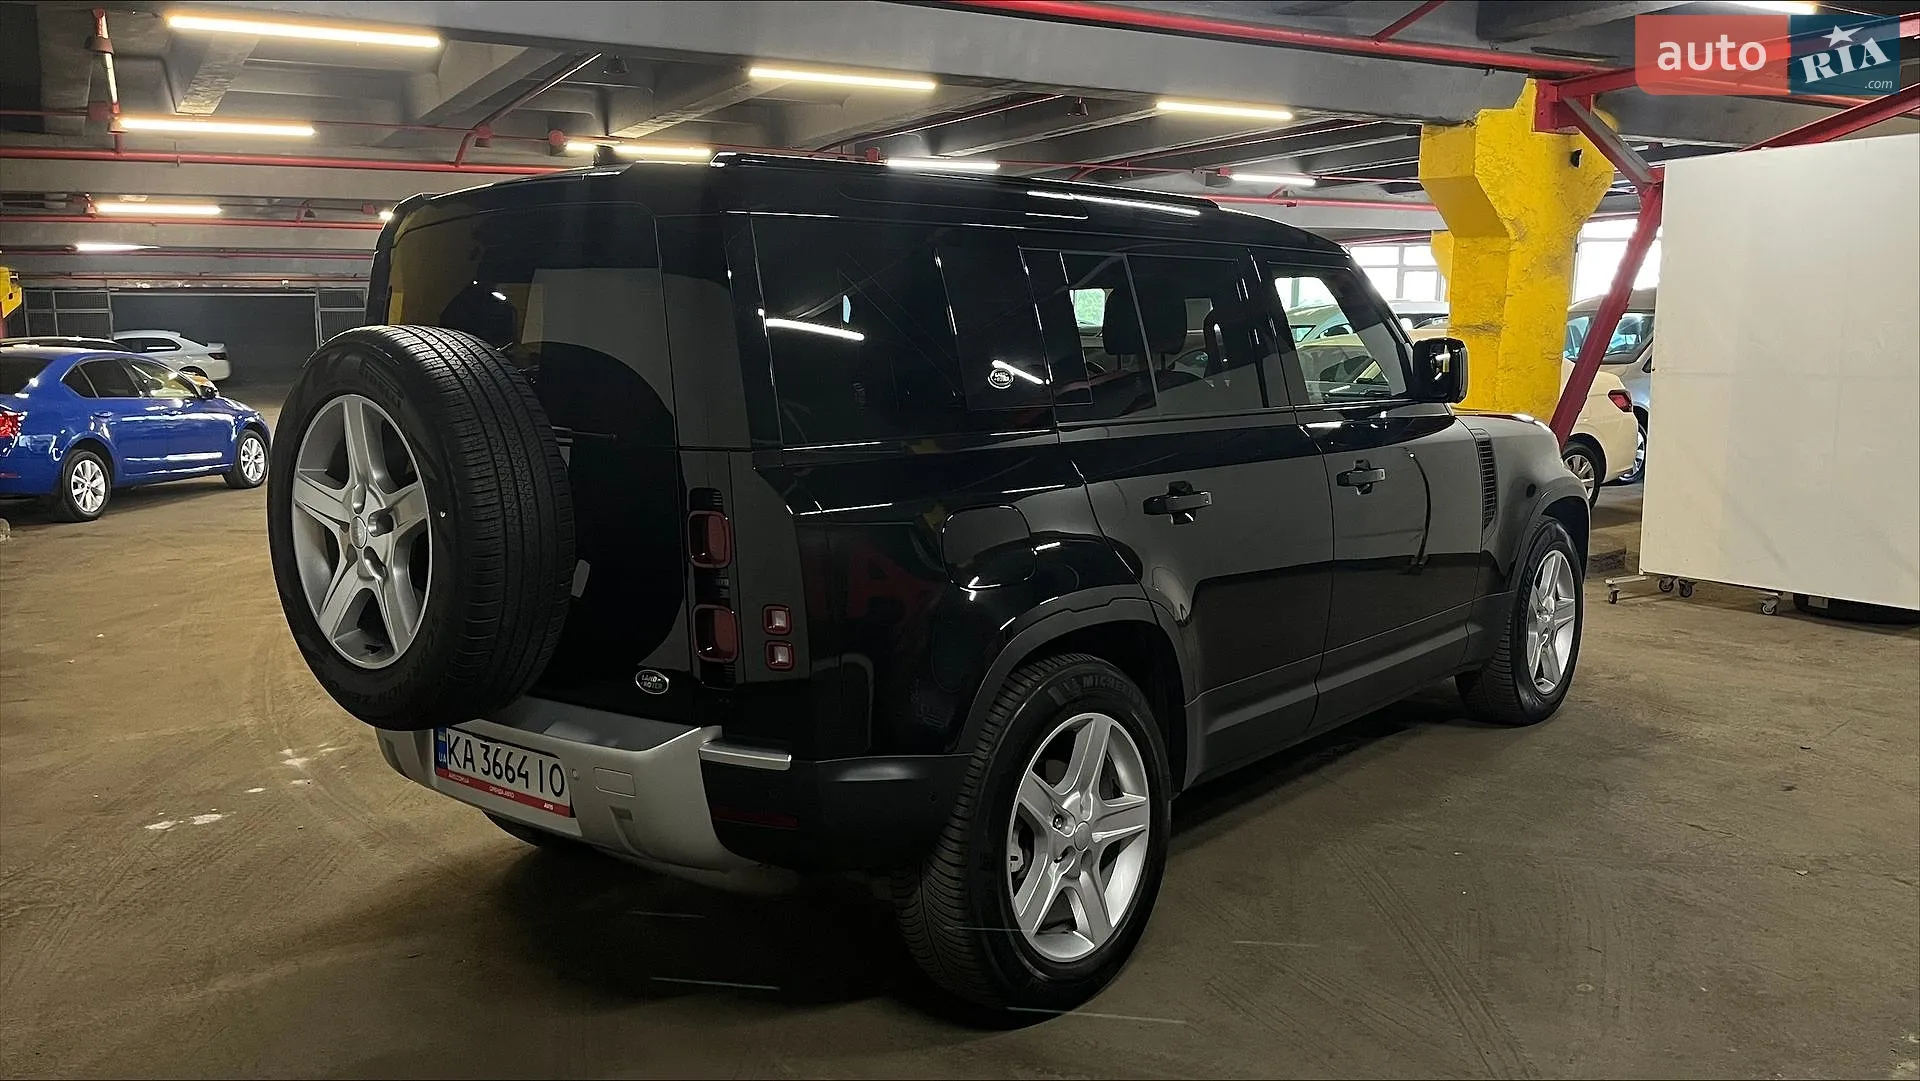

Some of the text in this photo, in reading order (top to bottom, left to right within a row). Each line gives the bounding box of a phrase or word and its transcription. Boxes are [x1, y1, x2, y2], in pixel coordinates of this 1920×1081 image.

[438, 750, 447, 764] UA
[447, 733, 565, 797] KA 3664 IO
